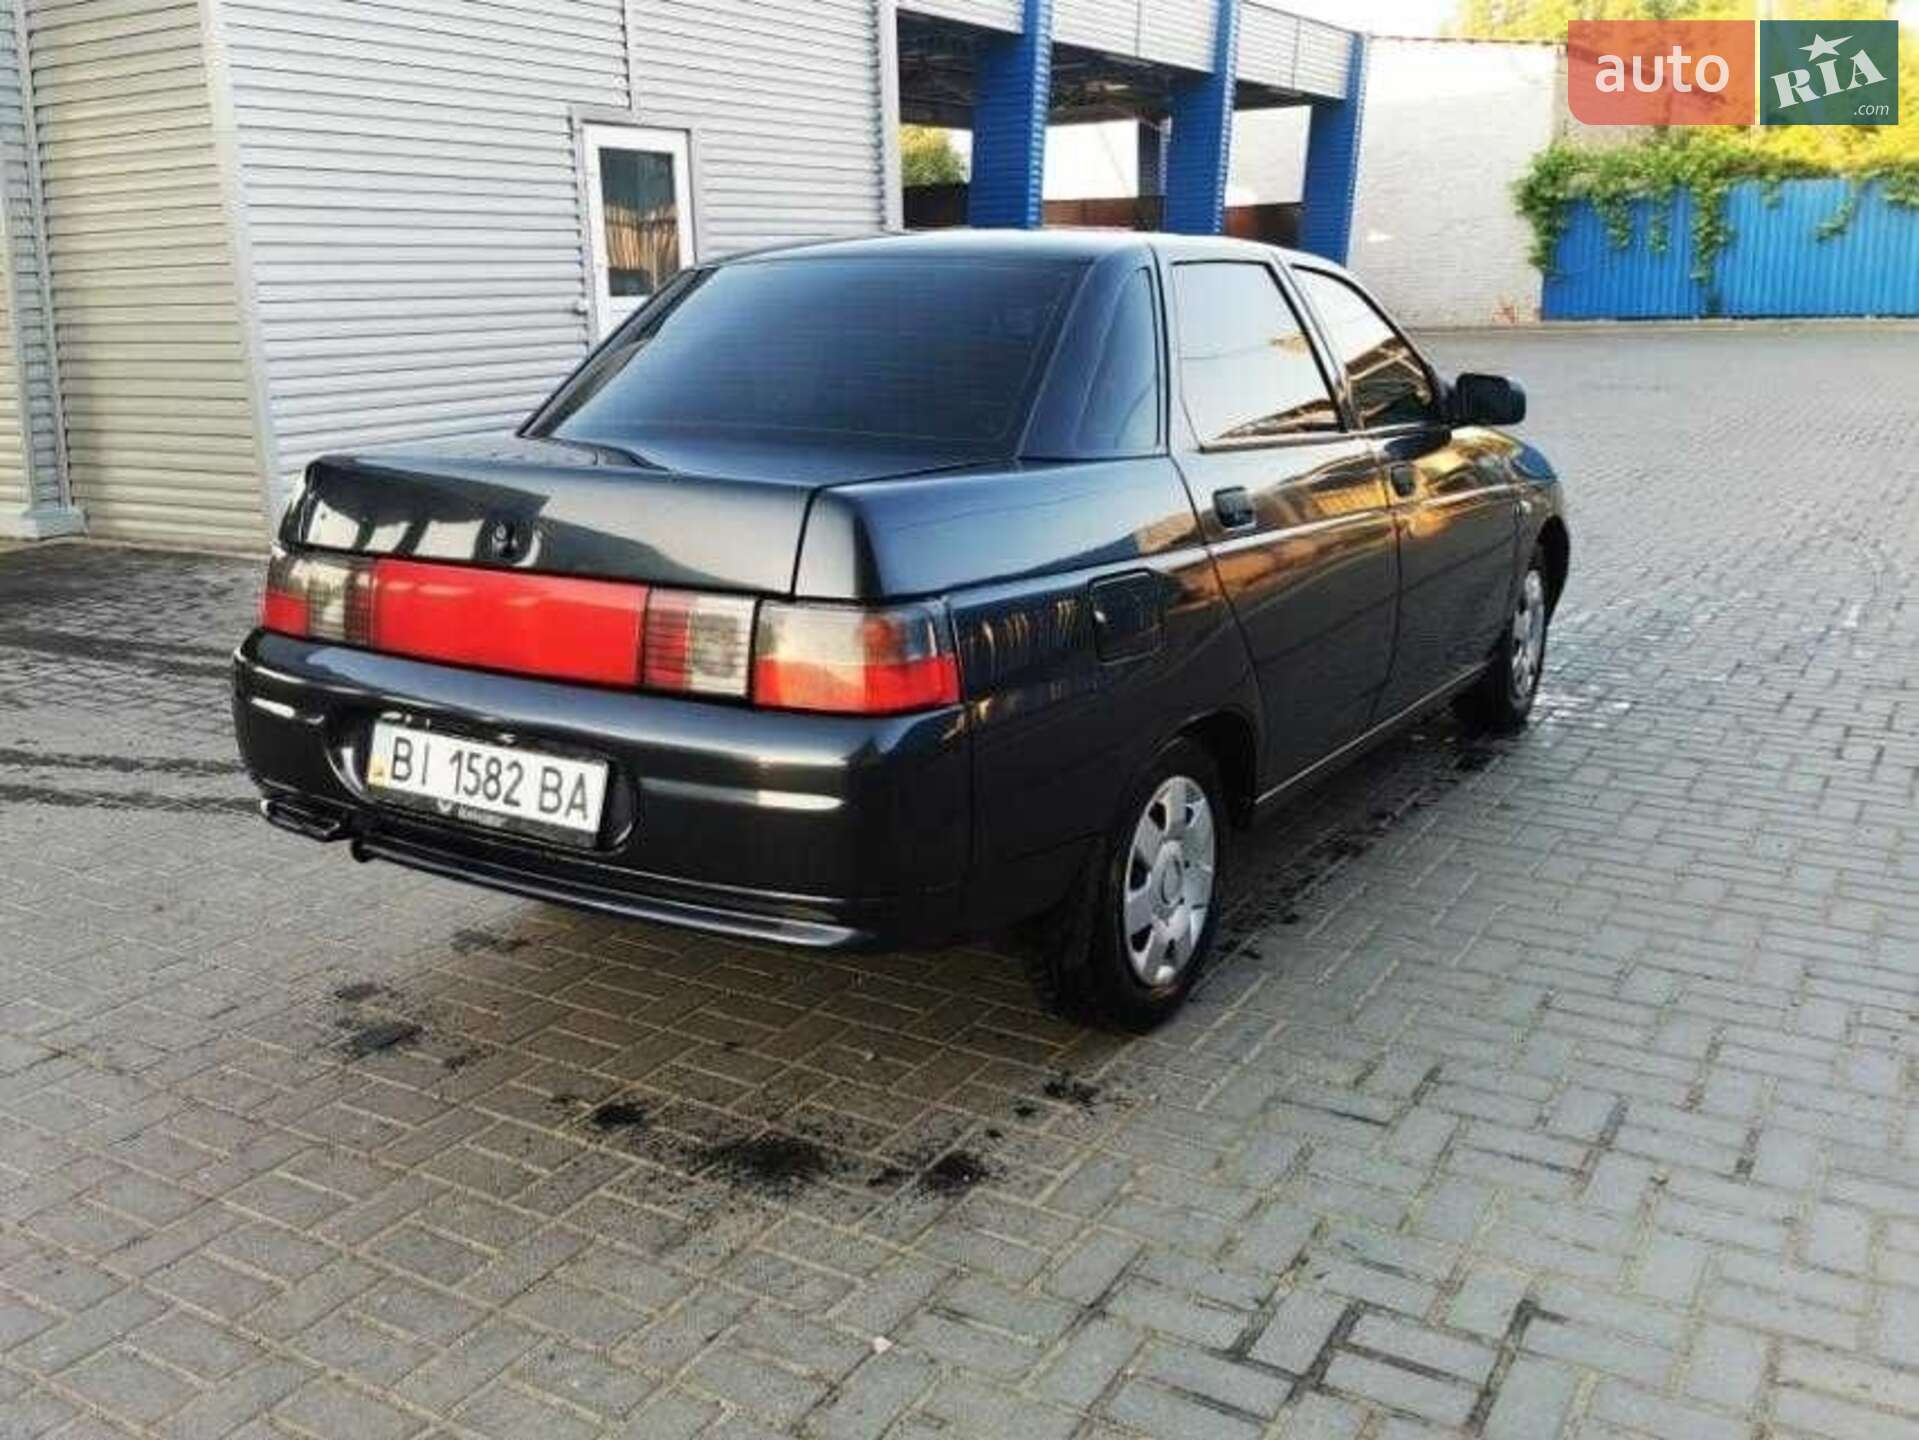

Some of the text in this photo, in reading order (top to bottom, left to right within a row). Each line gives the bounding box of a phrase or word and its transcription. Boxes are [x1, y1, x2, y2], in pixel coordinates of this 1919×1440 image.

[391, 736, 430, 786] BI
[449, 749, 524, 807] 1582
[538, 765, 589, 821] BA
